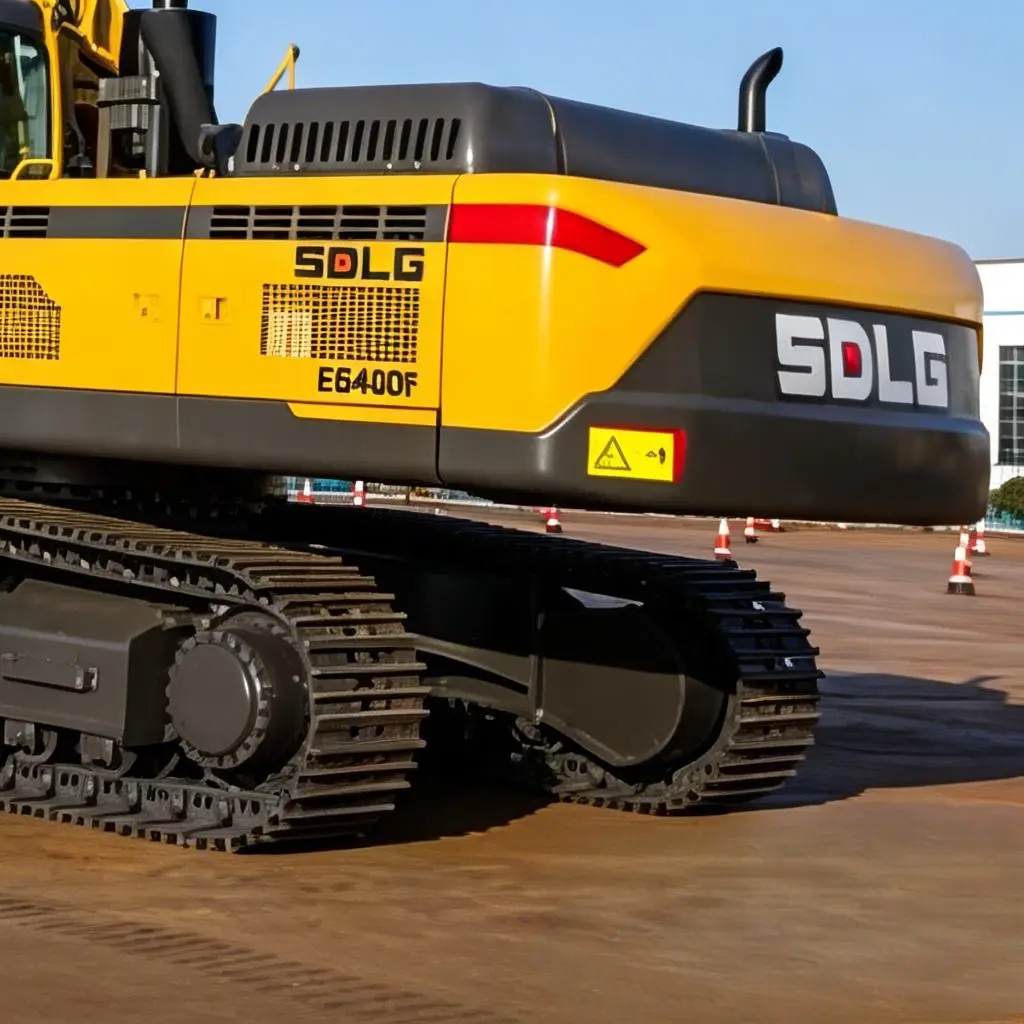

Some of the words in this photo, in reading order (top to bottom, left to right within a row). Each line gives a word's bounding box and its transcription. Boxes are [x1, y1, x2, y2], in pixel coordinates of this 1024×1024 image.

[294, 246, 425, 281] SDLG
[776, 313, 948, 408] SDLG
[317, 366, 418, 397] E6400F
